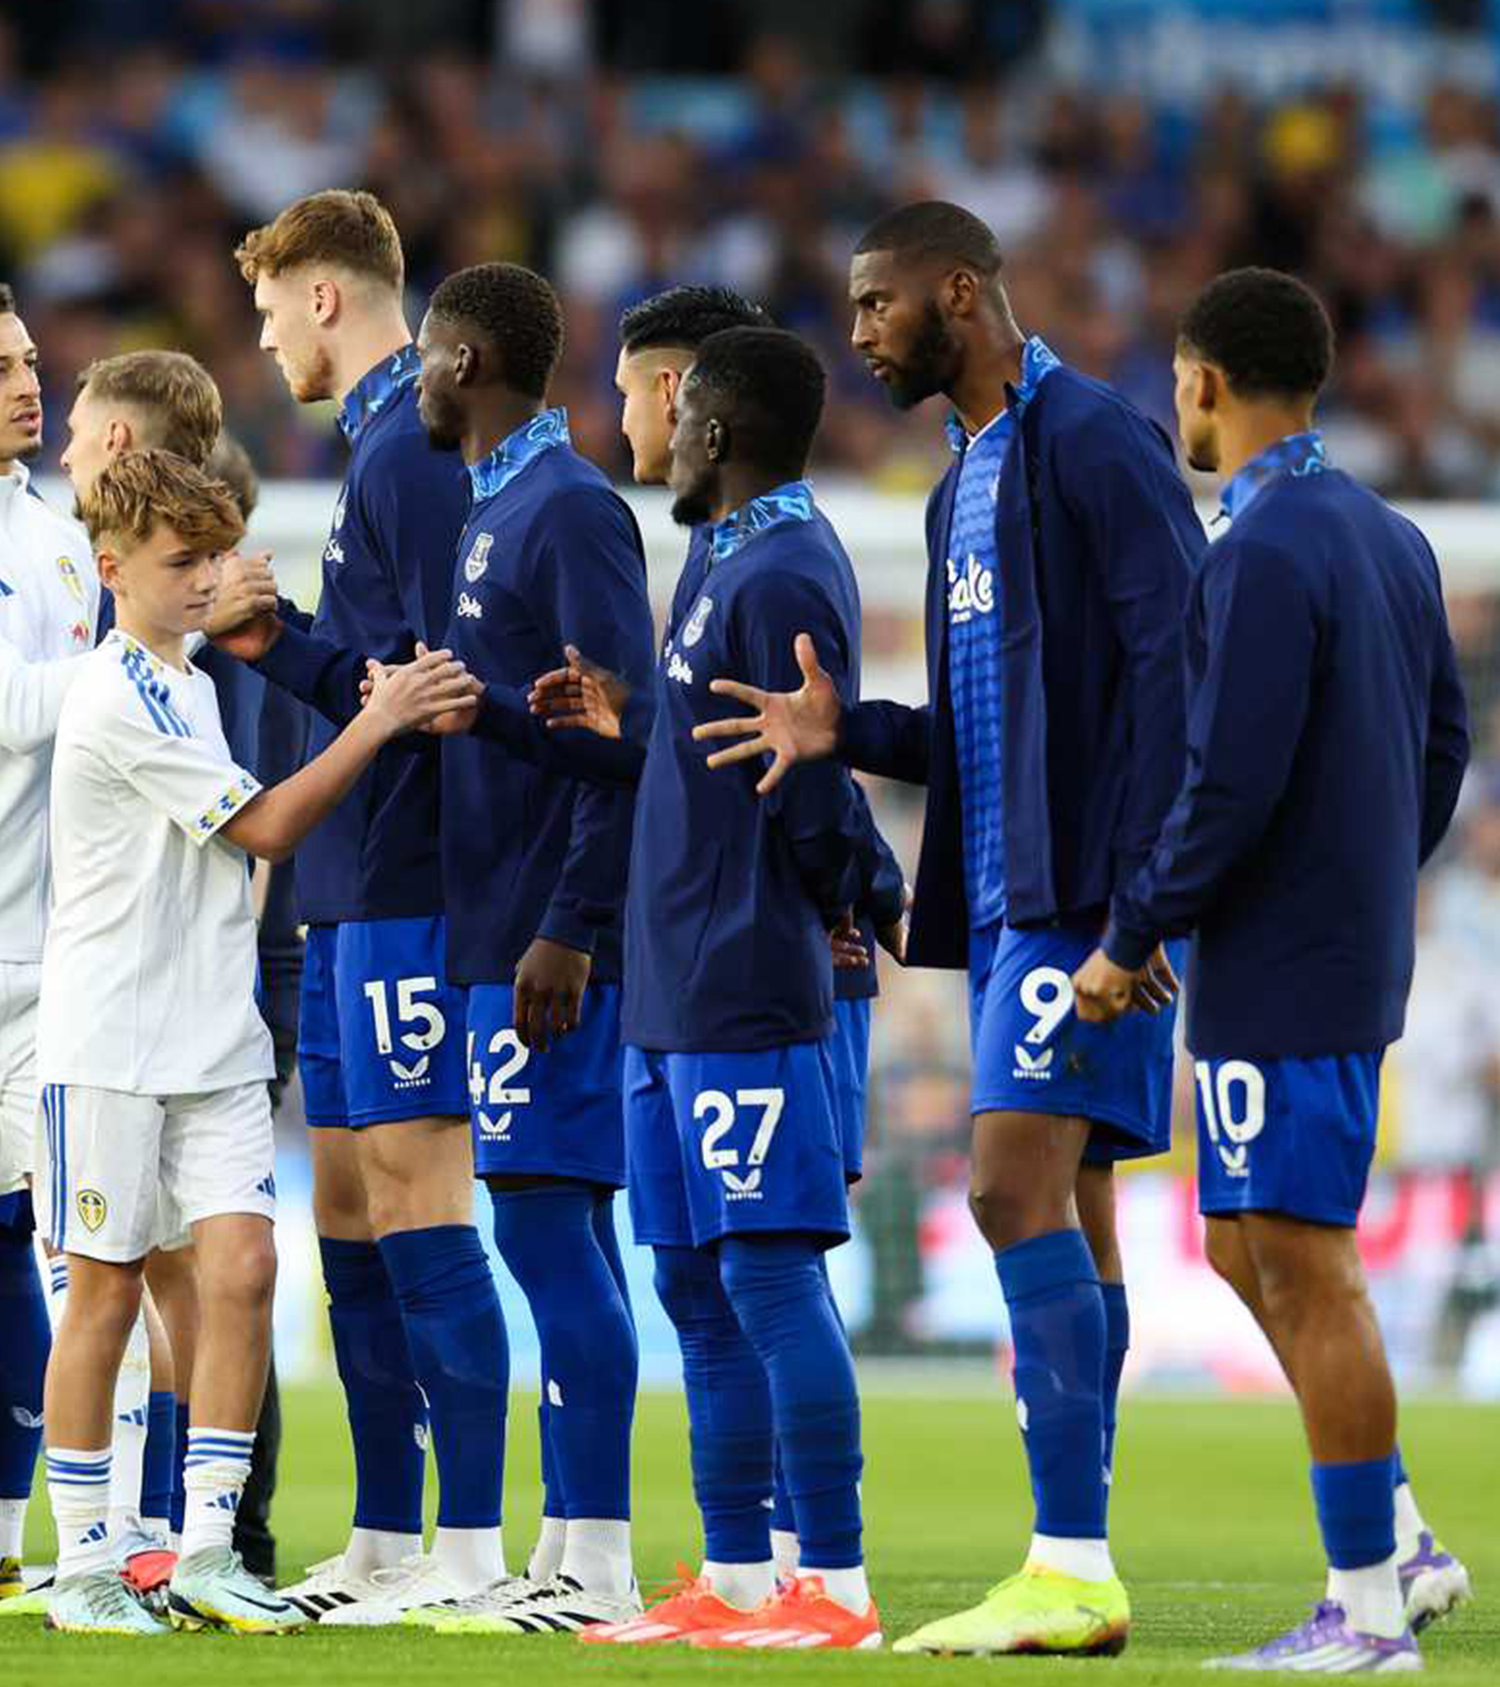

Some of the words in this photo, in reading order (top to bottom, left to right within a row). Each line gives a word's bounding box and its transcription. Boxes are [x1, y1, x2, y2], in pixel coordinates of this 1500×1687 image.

[363, 976, 446, 1054] 15
[1019, 966, 1074, 1044] 9
[467, 1028, 531, 1106] 42
[1195, 1060, 1265, 1144] 10
[693, 1087, 785, 1170] 27
